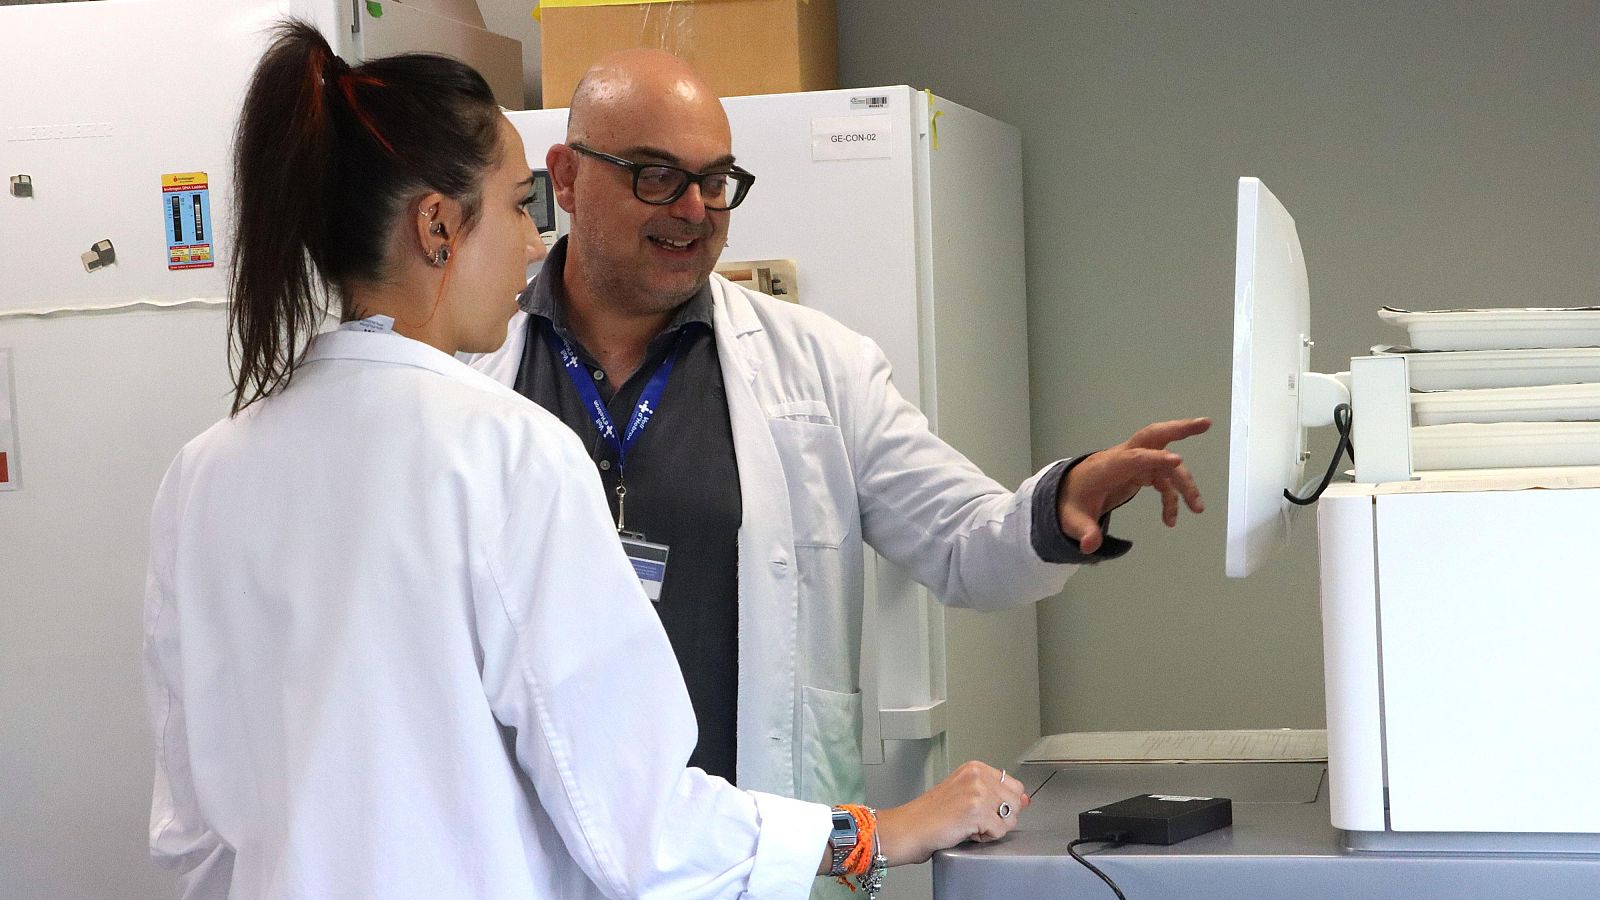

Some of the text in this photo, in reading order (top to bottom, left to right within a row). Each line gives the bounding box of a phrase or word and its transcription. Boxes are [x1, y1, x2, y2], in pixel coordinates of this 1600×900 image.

[830, 134, 876, 143] GE-CON-02
[594, 400, 608, 426] d'Hebron
[596, 418, 604, 431] Vall
[626, 412, 643, 440] d'Hebron
[639, 416, 649, 429] Vall
